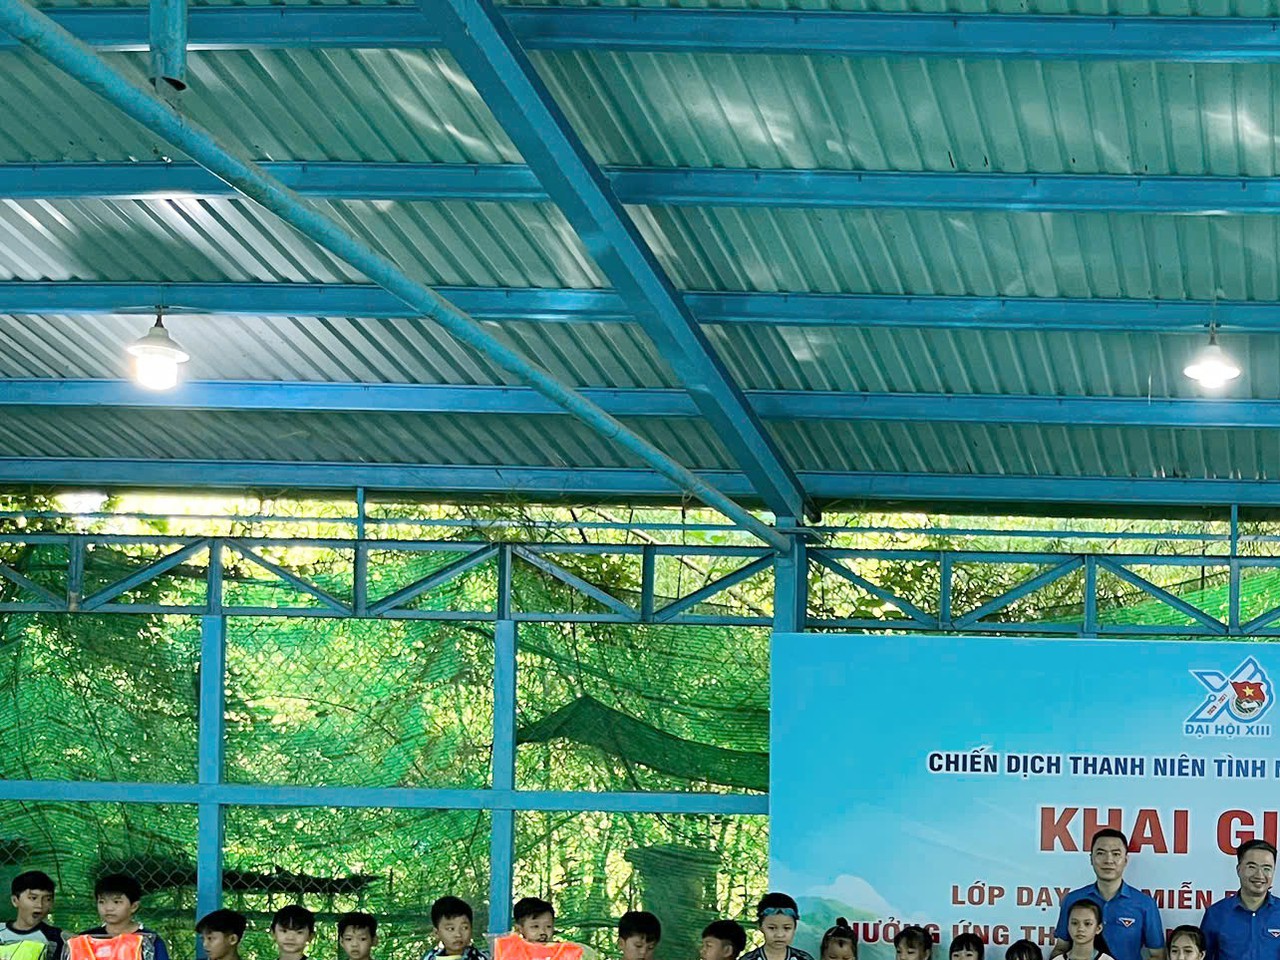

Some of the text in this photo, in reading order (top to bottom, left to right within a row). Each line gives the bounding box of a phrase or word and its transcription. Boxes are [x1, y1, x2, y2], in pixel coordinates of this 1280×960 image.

[1185, 722, 1270, 738] ĐẠI HỘI XIII
[928, 747, 998, 773] CHIẾN
[1006, 755, 1061, 778] DỊCH
[1069, 756, 1145, 776] THANH
[1153, 754, 1205, 777] NIÊN
[1213, 755, 1266, 778] TÌNH
[1039, 806, 1189, 854] KHAI
[951, 880, 1005, 906] LỚP
[1016, 886, 1071, 911] DẠY
